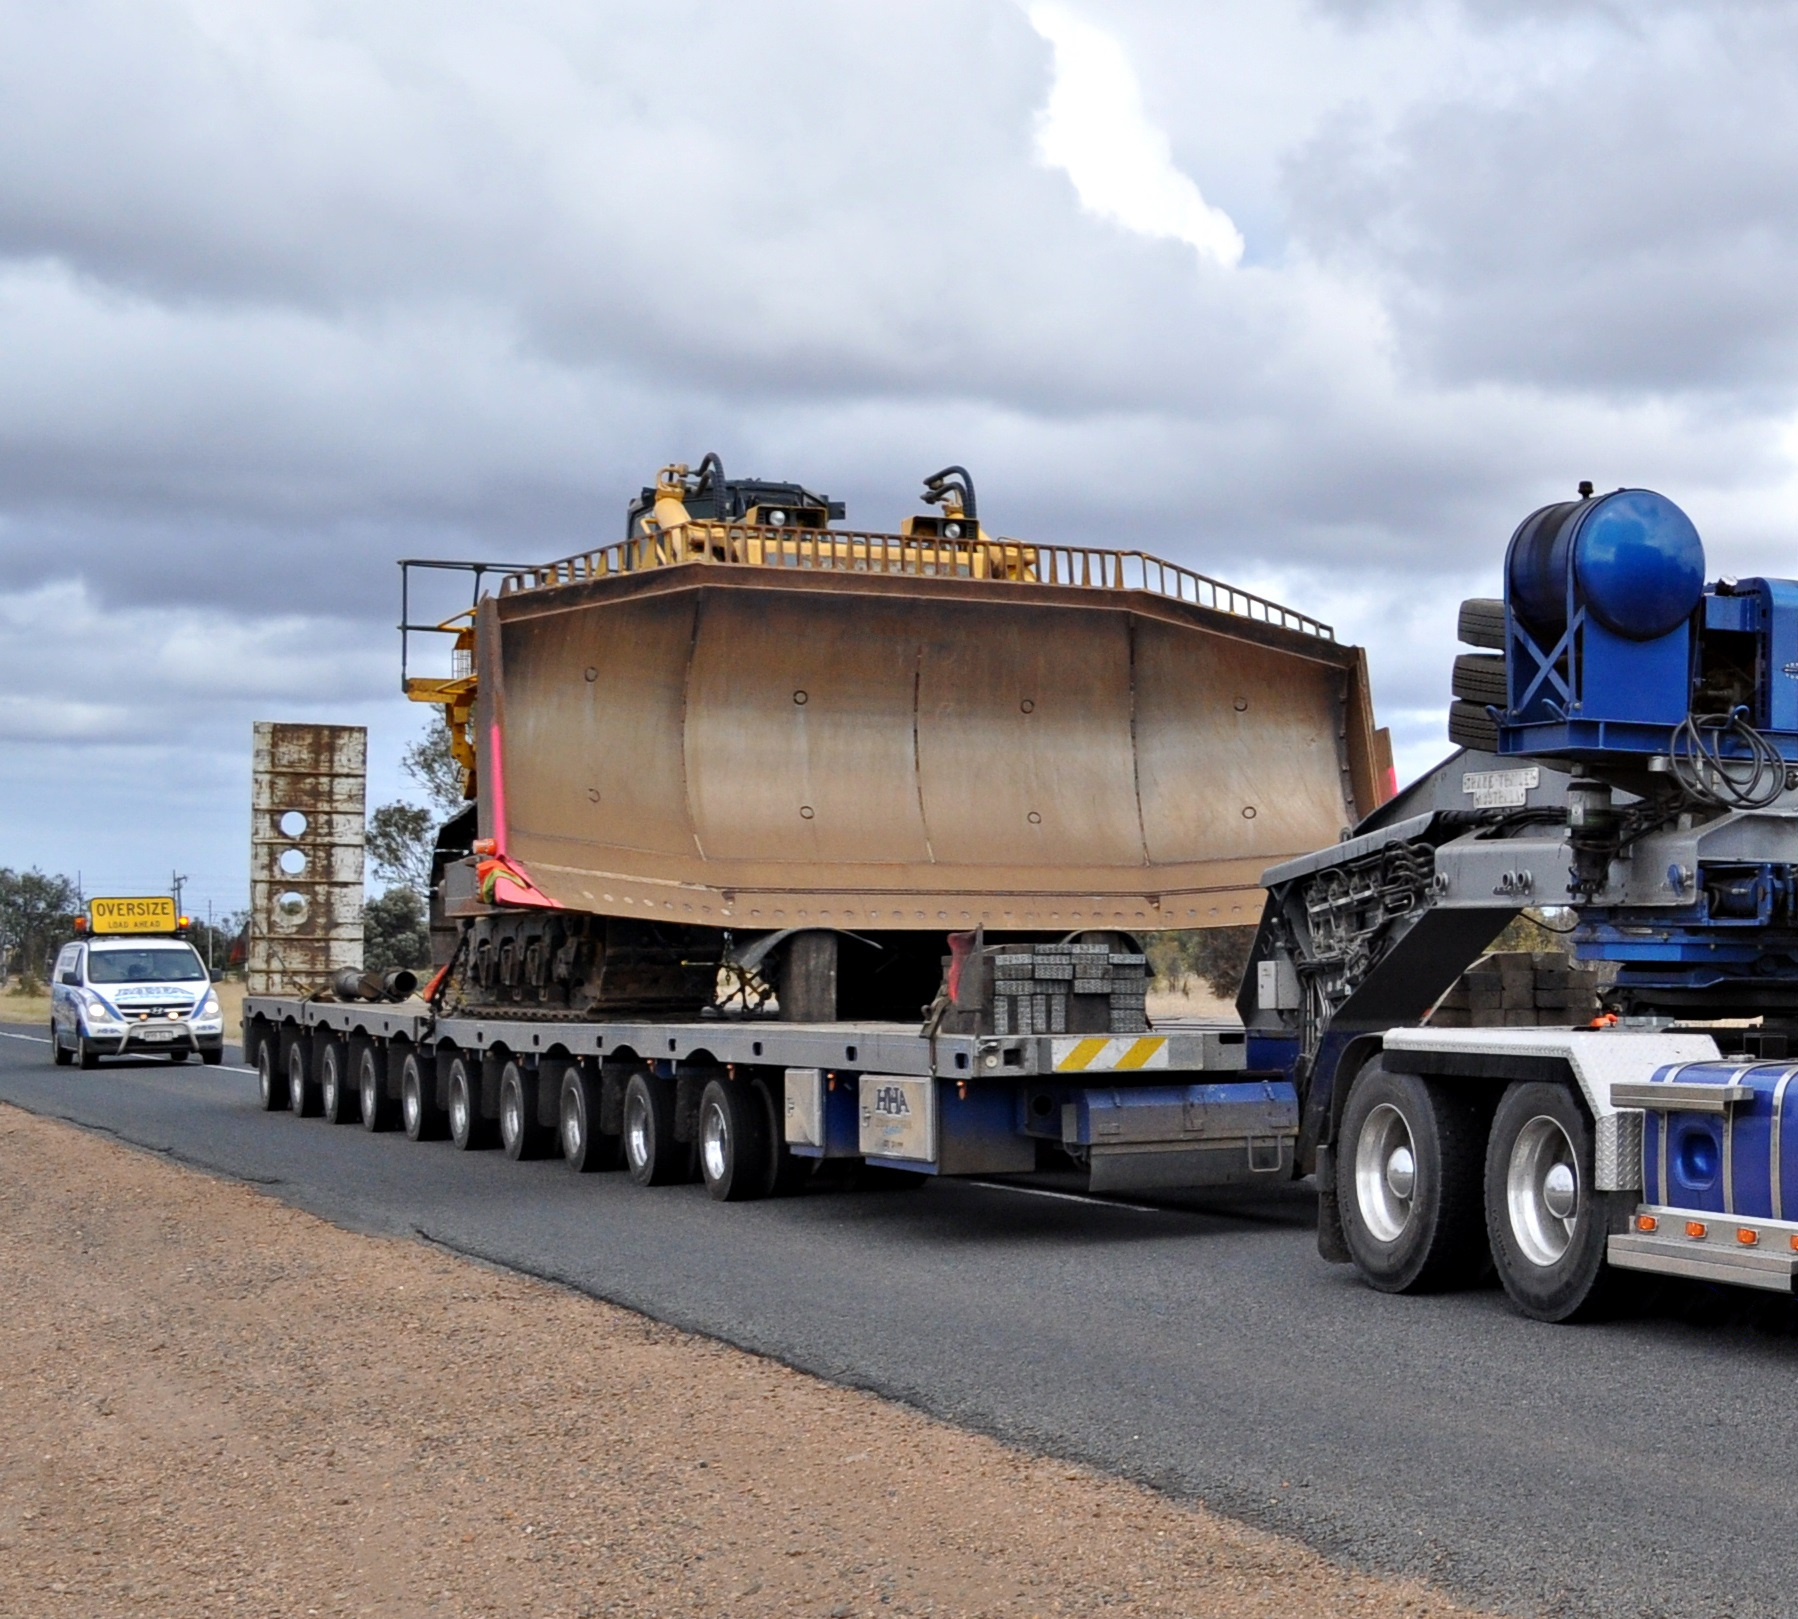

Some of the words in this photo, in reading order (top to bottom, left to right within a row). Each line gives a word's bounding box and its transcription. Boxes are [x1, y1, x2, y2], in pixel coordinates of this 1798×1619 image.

[96, 902, 170, 917] OVERSIZE
[108, 921, 128, 929] LOAD
[134, 920, 161, 929] AHEAD
[876, 1087, 910, 1115] HHA
